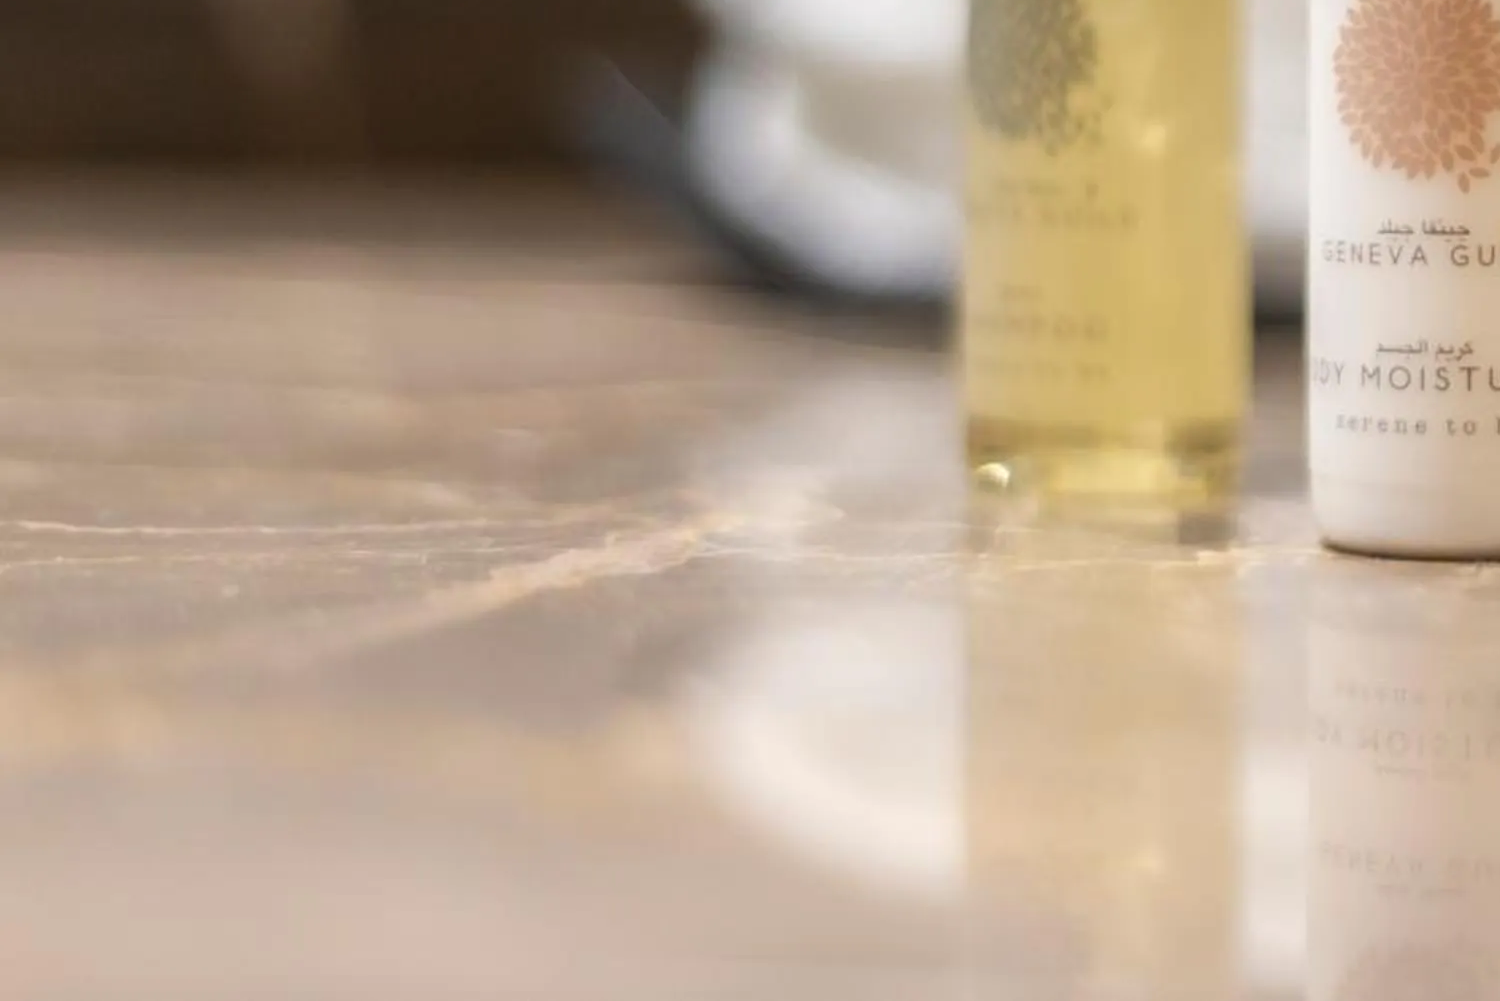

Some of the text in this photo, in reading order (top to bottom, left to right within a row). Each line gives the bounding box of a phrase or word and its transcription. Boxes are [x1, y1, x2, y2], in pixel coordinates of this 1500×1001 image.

[1322, 240, 1429, 266] GENEVA
[1335, 414, 1428, 436] serene
[1445, 417, 1478, 437] to
